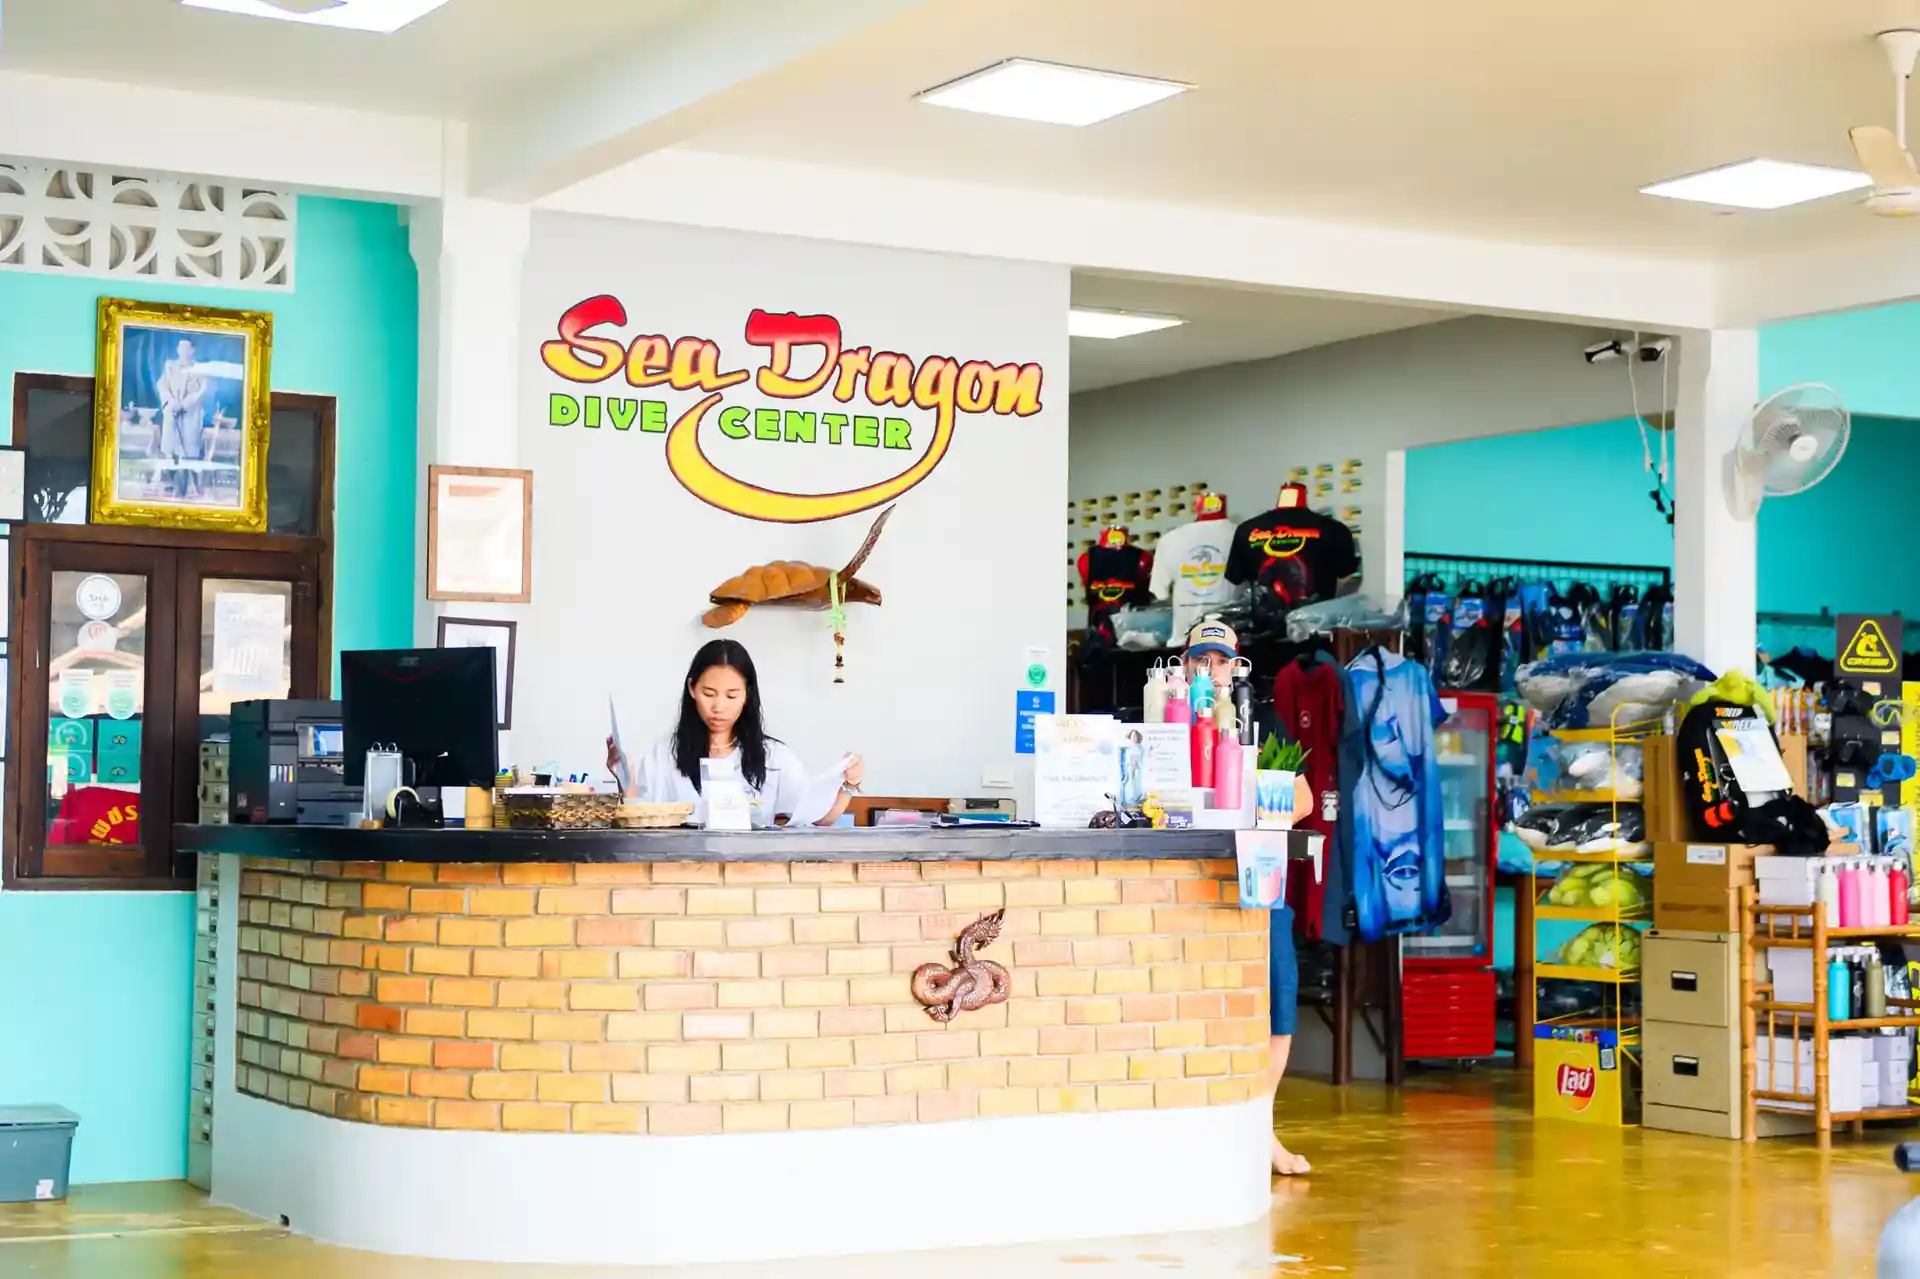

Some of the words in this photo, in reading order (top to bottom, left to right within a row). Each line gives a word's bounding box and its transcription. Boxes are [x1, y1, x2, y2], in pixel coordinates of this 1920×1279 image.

[540, 294, 750, 392] Sea
[745, 309, 1043, 417] Dragon
[549, 393, 668, 433] DIVE
[718, 406, 912, 450] CENTER
